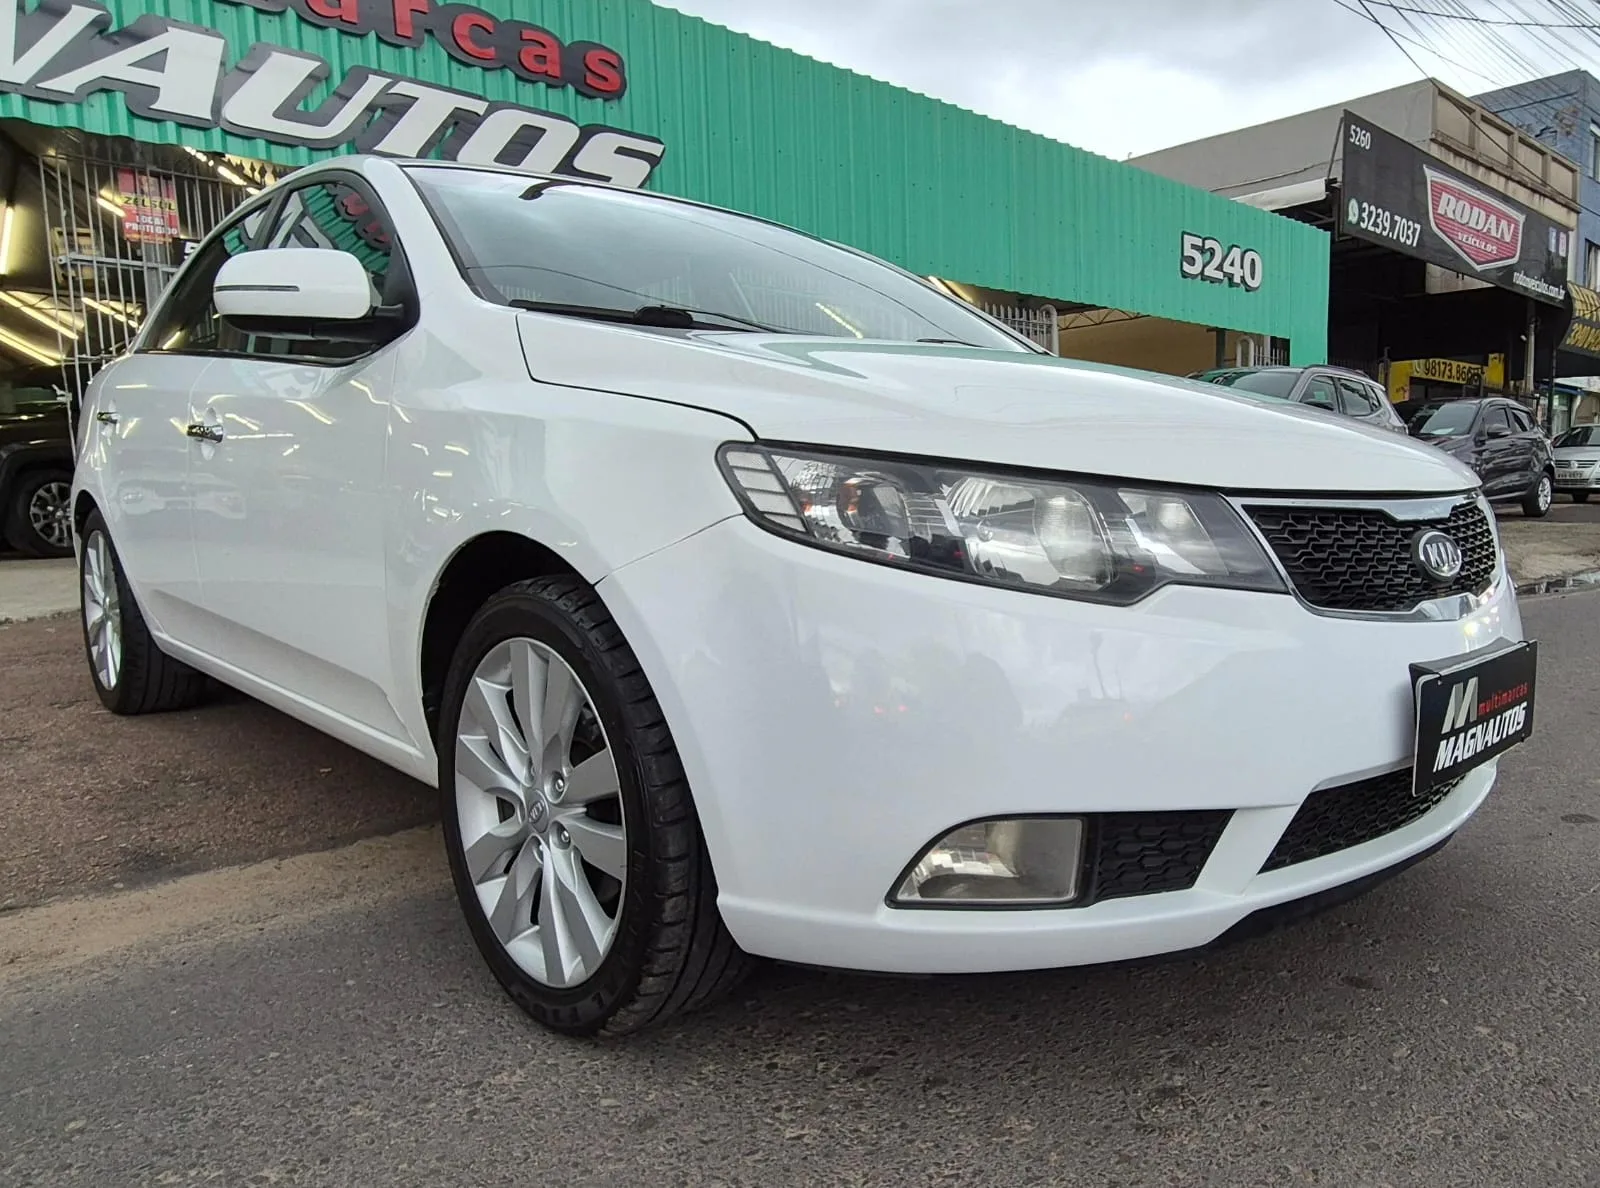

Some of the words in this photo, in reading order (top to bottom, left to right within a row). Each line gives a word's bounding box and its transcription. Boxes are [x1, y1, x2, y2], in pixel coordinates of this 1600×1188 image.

[1350, 125, 1371, 150] 5260
[1360, 202, 1421, 247] 3239.7037
[1438, 192, 1515, 243] RODAN
[1182, 232, 1262, 289] 5240
[1426, 542, 1459, 569] KIA
[1478, 682, 1529, 716] multimarcas
[1433, 701, 1527, 773] MAGNAUTOS
